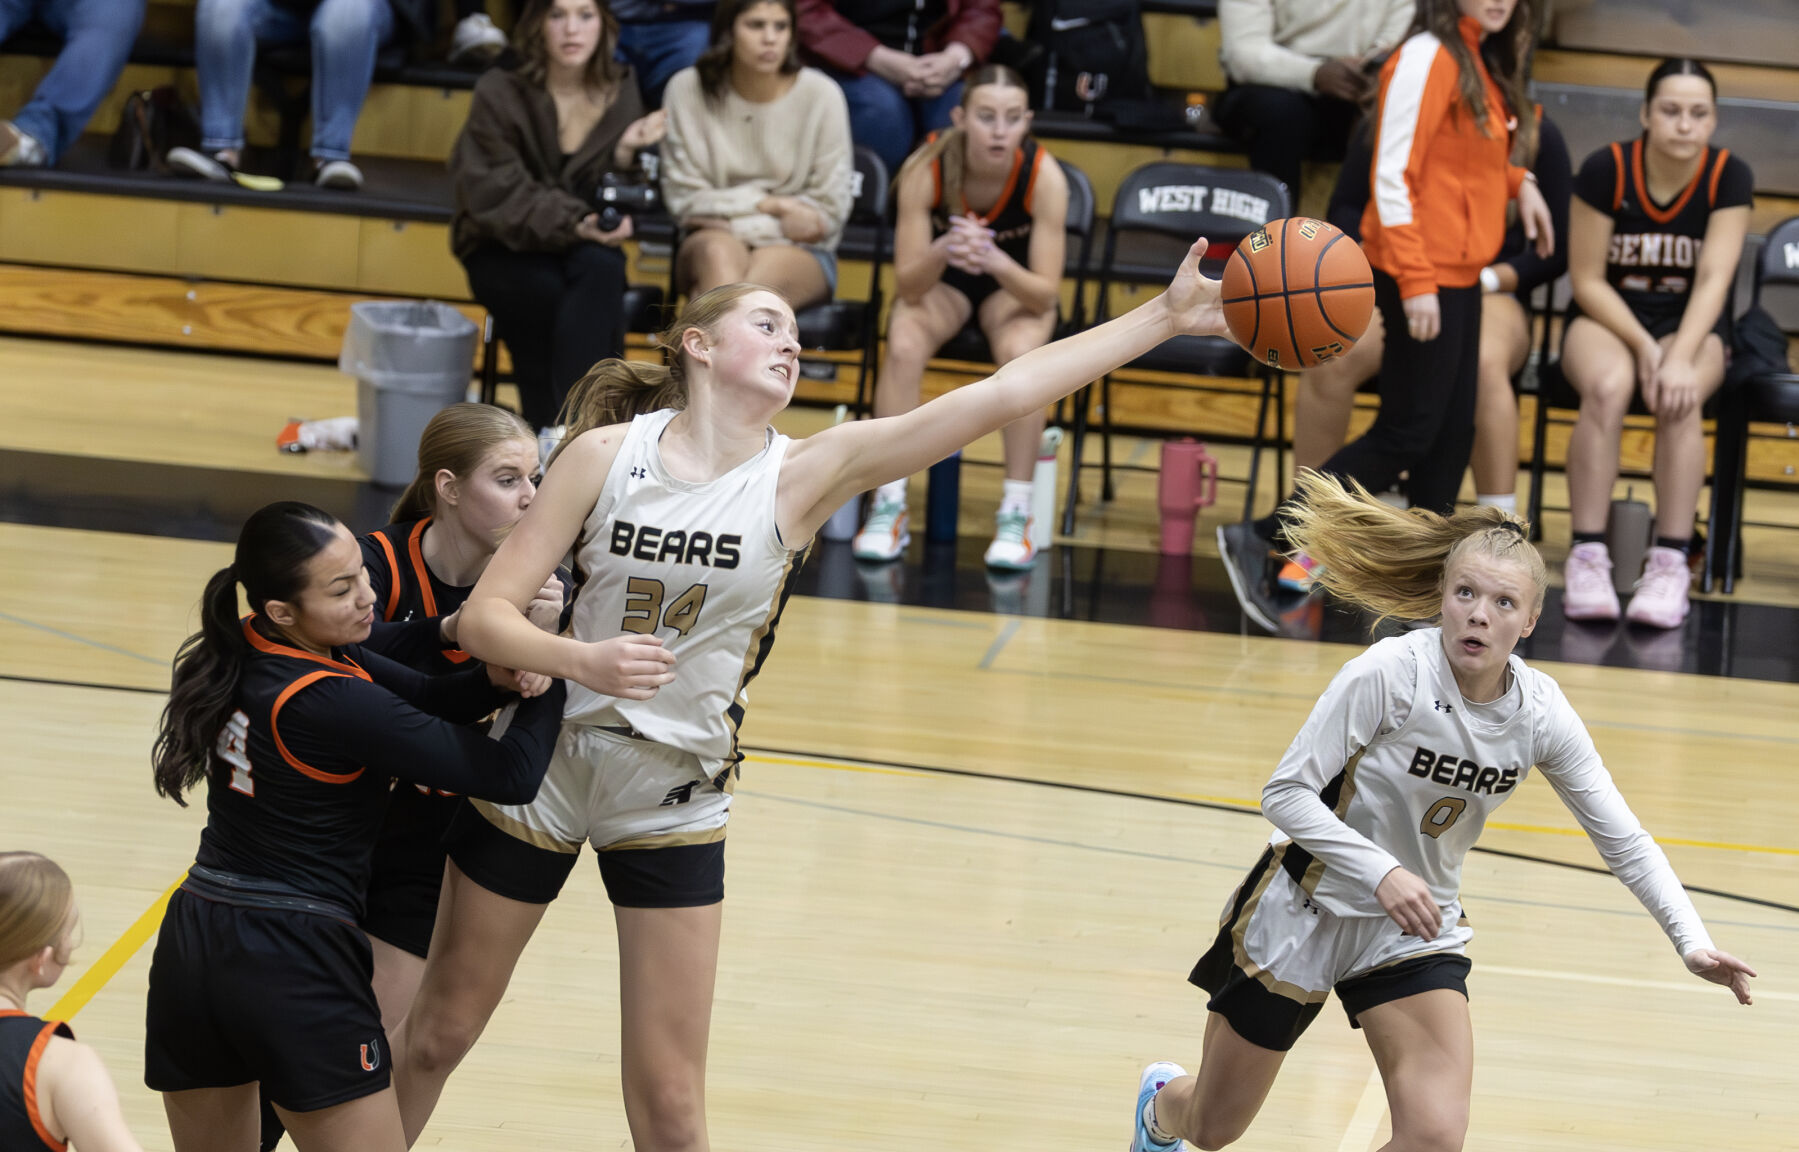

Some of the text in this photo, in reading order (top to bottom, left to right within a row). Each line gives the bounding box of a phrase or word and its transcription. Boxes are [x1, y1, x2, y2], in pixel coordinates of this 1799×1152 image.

[1138, 184, 1270, 226] WEST HIGH
[609, 519, 743, 570] BEARS
[620, 576, 708, 639] 34
[1407, 746, 1519, 795] BEARS
[1420, 796, 1467, 839] 0
